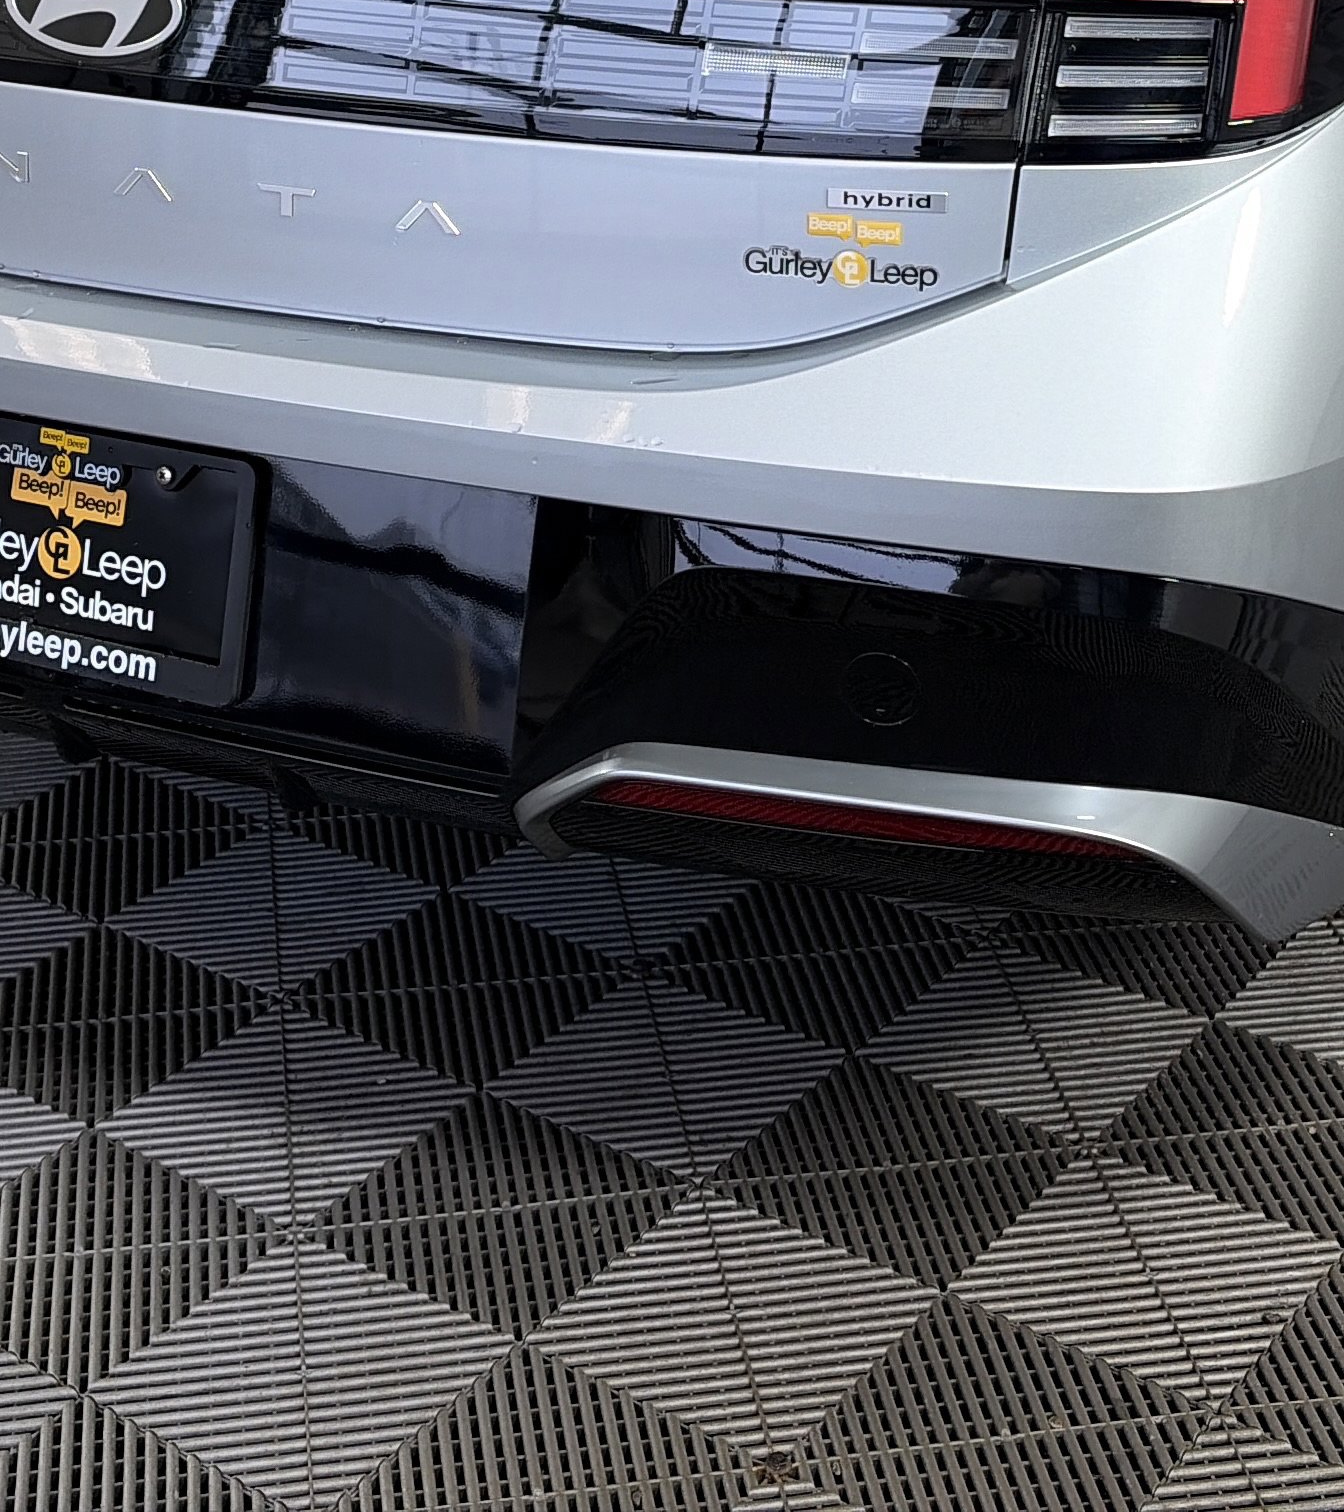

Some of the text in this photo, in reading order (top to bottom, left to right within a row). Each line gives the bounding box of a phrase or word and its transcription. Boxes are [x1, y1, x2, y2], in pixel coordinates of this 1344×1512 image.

[843, 191, 931, 209] hybrid
[808, 216, 900, 242] Beep! Beep!
[745, 249, 833, 284] Gurley
[870, 259, 938, 291] Leep
[42, 430, 88, 450] Beep! Beep!
[74, 456, 121, 489] Leep
[18, 472, 122, 519] Beep! Beep!
[82, 538, 166, 597] Leep
[59, 587, 155, 632] Subaru
